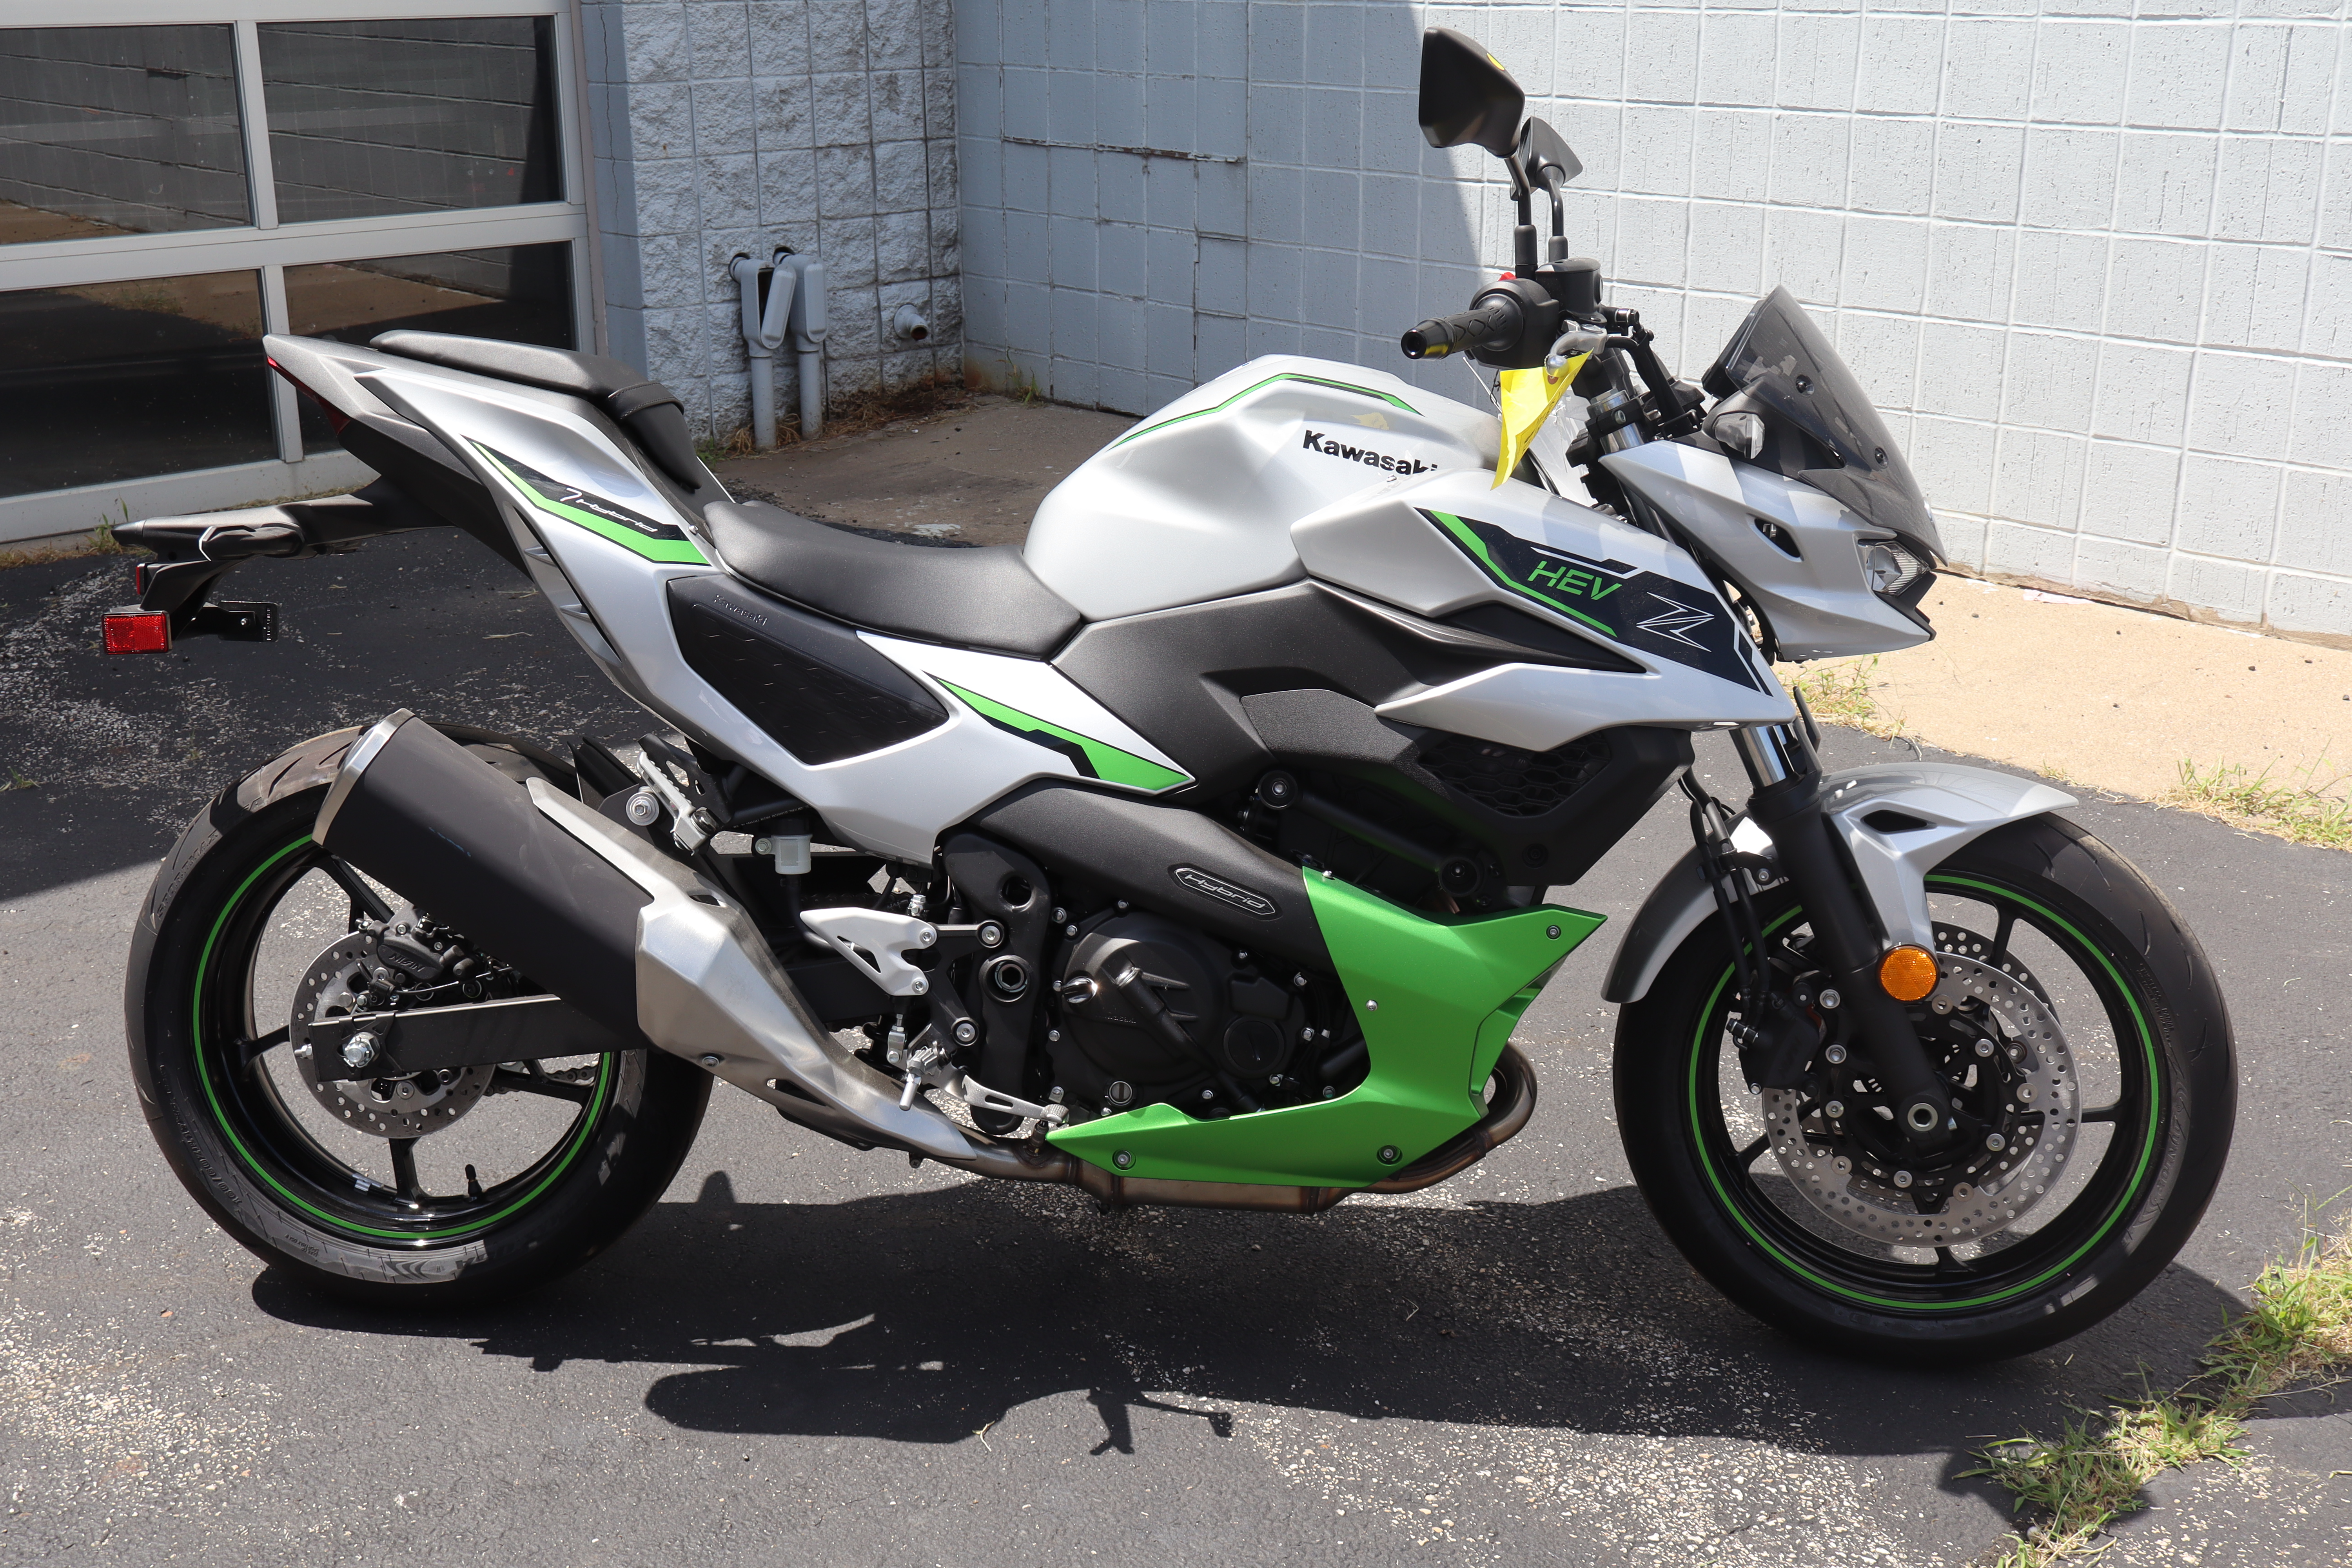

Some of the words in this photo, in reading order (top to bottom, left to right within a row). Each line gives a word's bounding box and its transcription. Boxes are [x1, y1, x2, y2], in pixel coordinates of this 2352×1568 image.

[575, 498, 659, 533] Hybrid
[1526, 560, 1623, 601] HEV
[713, 594, 768, 626] Kawasaki
[1184, 874, 1265, 909] Hybrid
